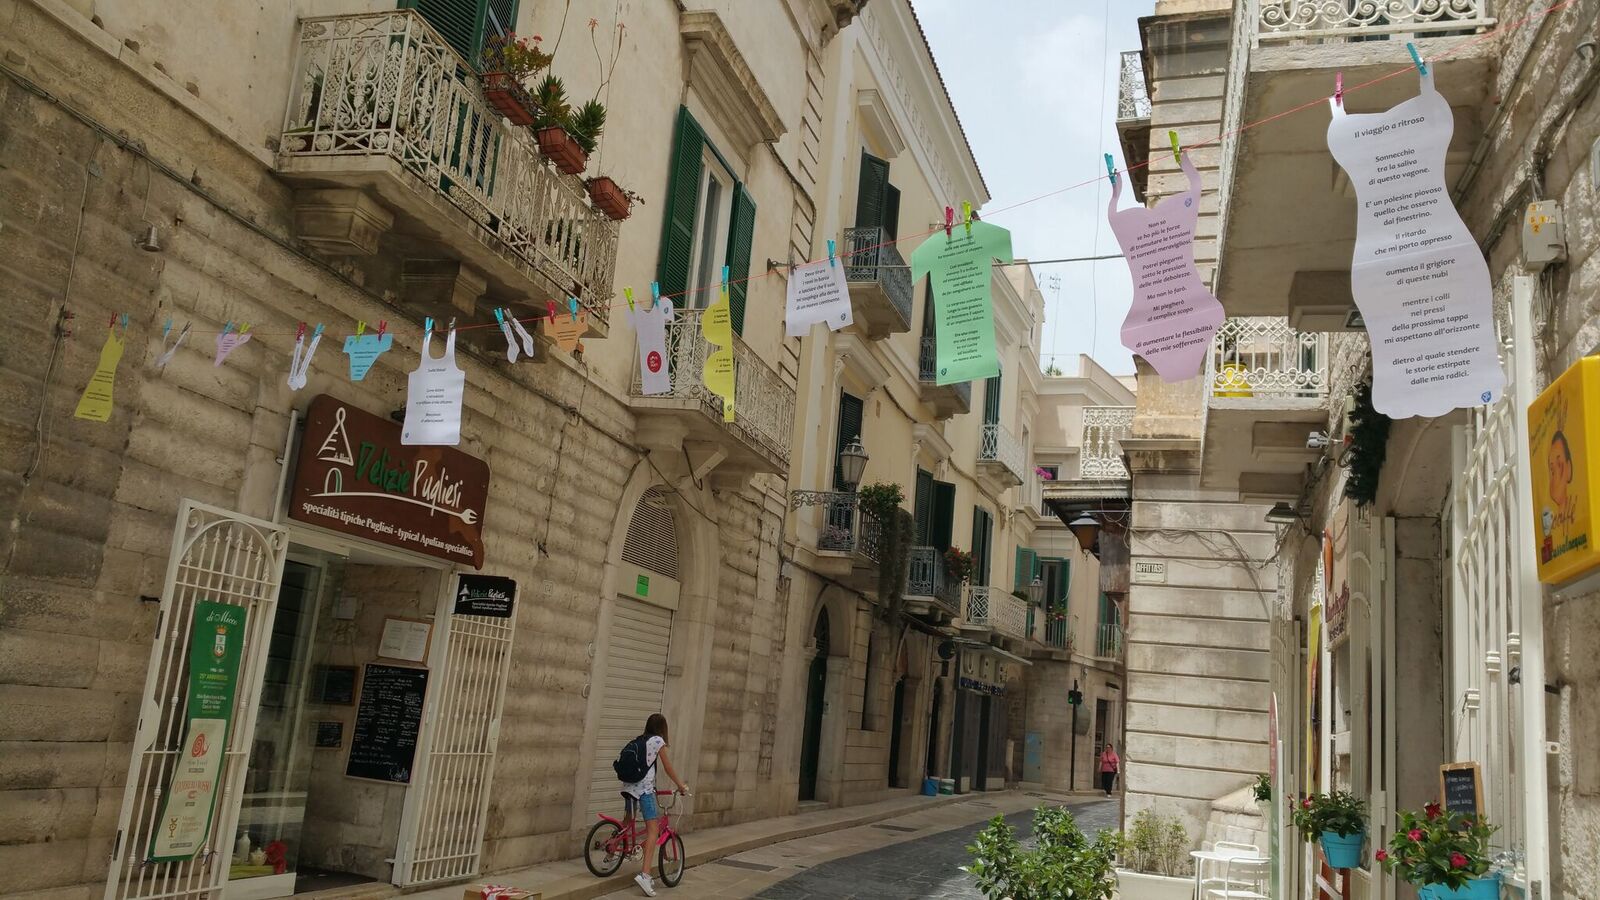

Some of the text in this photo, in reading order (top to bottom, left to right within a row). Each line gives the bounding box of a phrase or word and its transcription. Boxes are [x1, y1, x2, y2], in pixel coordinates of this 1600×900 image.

[1361, 124, 1390, 137] viaggio
[1398, 116, 1425, 128] ritroso
[1375, 148, 1415, 162] Sonnecchio
[1377, 165, 1388, 173] tra
[1397, 158, 1418, 168] saliva
[1368, 168, 1430, 186] di questo vagone.
[1384, 192, 1413, 208] polesine
[1414, 186, 1442, 199] piovoso
[1373, 198, 1438, 218] quello che osservo
[1148, 221, 1159, 229] Non
[1383, 212, 1432, 226] dal finestrino.
[1166, 224, 1180, 234] forze
[1402, 228, 1427, 238] ritardo
[1135, 238, 1162, 250] tramutare
[1169, 230, 1191, 240] tensioni
[1399, 241, 1418, 254] porto
[1420, 234, 1452, 247] appresso
[1136, 249, 1156, 259] torrenti
[1142, 255, 1183, 270] Potrei piegarmi
[1162, 263, 1186, 275] pressioni
[1385, 257, 1456, 276] aumenta il grigiore
[1139, 281, 1152, 289] delle
[1405, 273, 1430, 285] queste
[1432, 270, 1448, 279] nubi
[1160, 299, 1185, 311] piegherò
[1402, 298, 1430, 307] mentre
[1435, 293, 1450, 301] colli
[1153, 310, 1176, 321] semplice
[1176, 307, 1194, 317] scopo
[1424, 306, 1445, 317] pressi
[1392, 314, 1469, 332] della prossima tappa
[1143, 333, 1174, 346] aumentare
[1182, 324, 1213, 338] flessibilità
[1395, 330, 1432, 344] aspettano
[1434, 322, 1480, 336] all'orizzonte
[1145, 337, 1205, 356] delle mie sofferenze.
[1392, 356, 1415, 365] dietro
[1425, 352, 1445, 362] quale
[1447, 345, 1480, 356] stendere
[1414, 364, 1435, 373] storie
[1437, 359, 1471, 372] estirpate
[1410, 377, 1429, 385] dalle
[1446, 370, 1469, 379] radici.
[355, 441, 464, 516] Delizie Pugliesi
[302, 502, 340, 520] specialità
[340, 511, 366, 527] tipiche
[366, 518, 394, 534] Pugliesi
[398, 528, 420, 543] typical
[420, 534, 444, 549] Apulian
